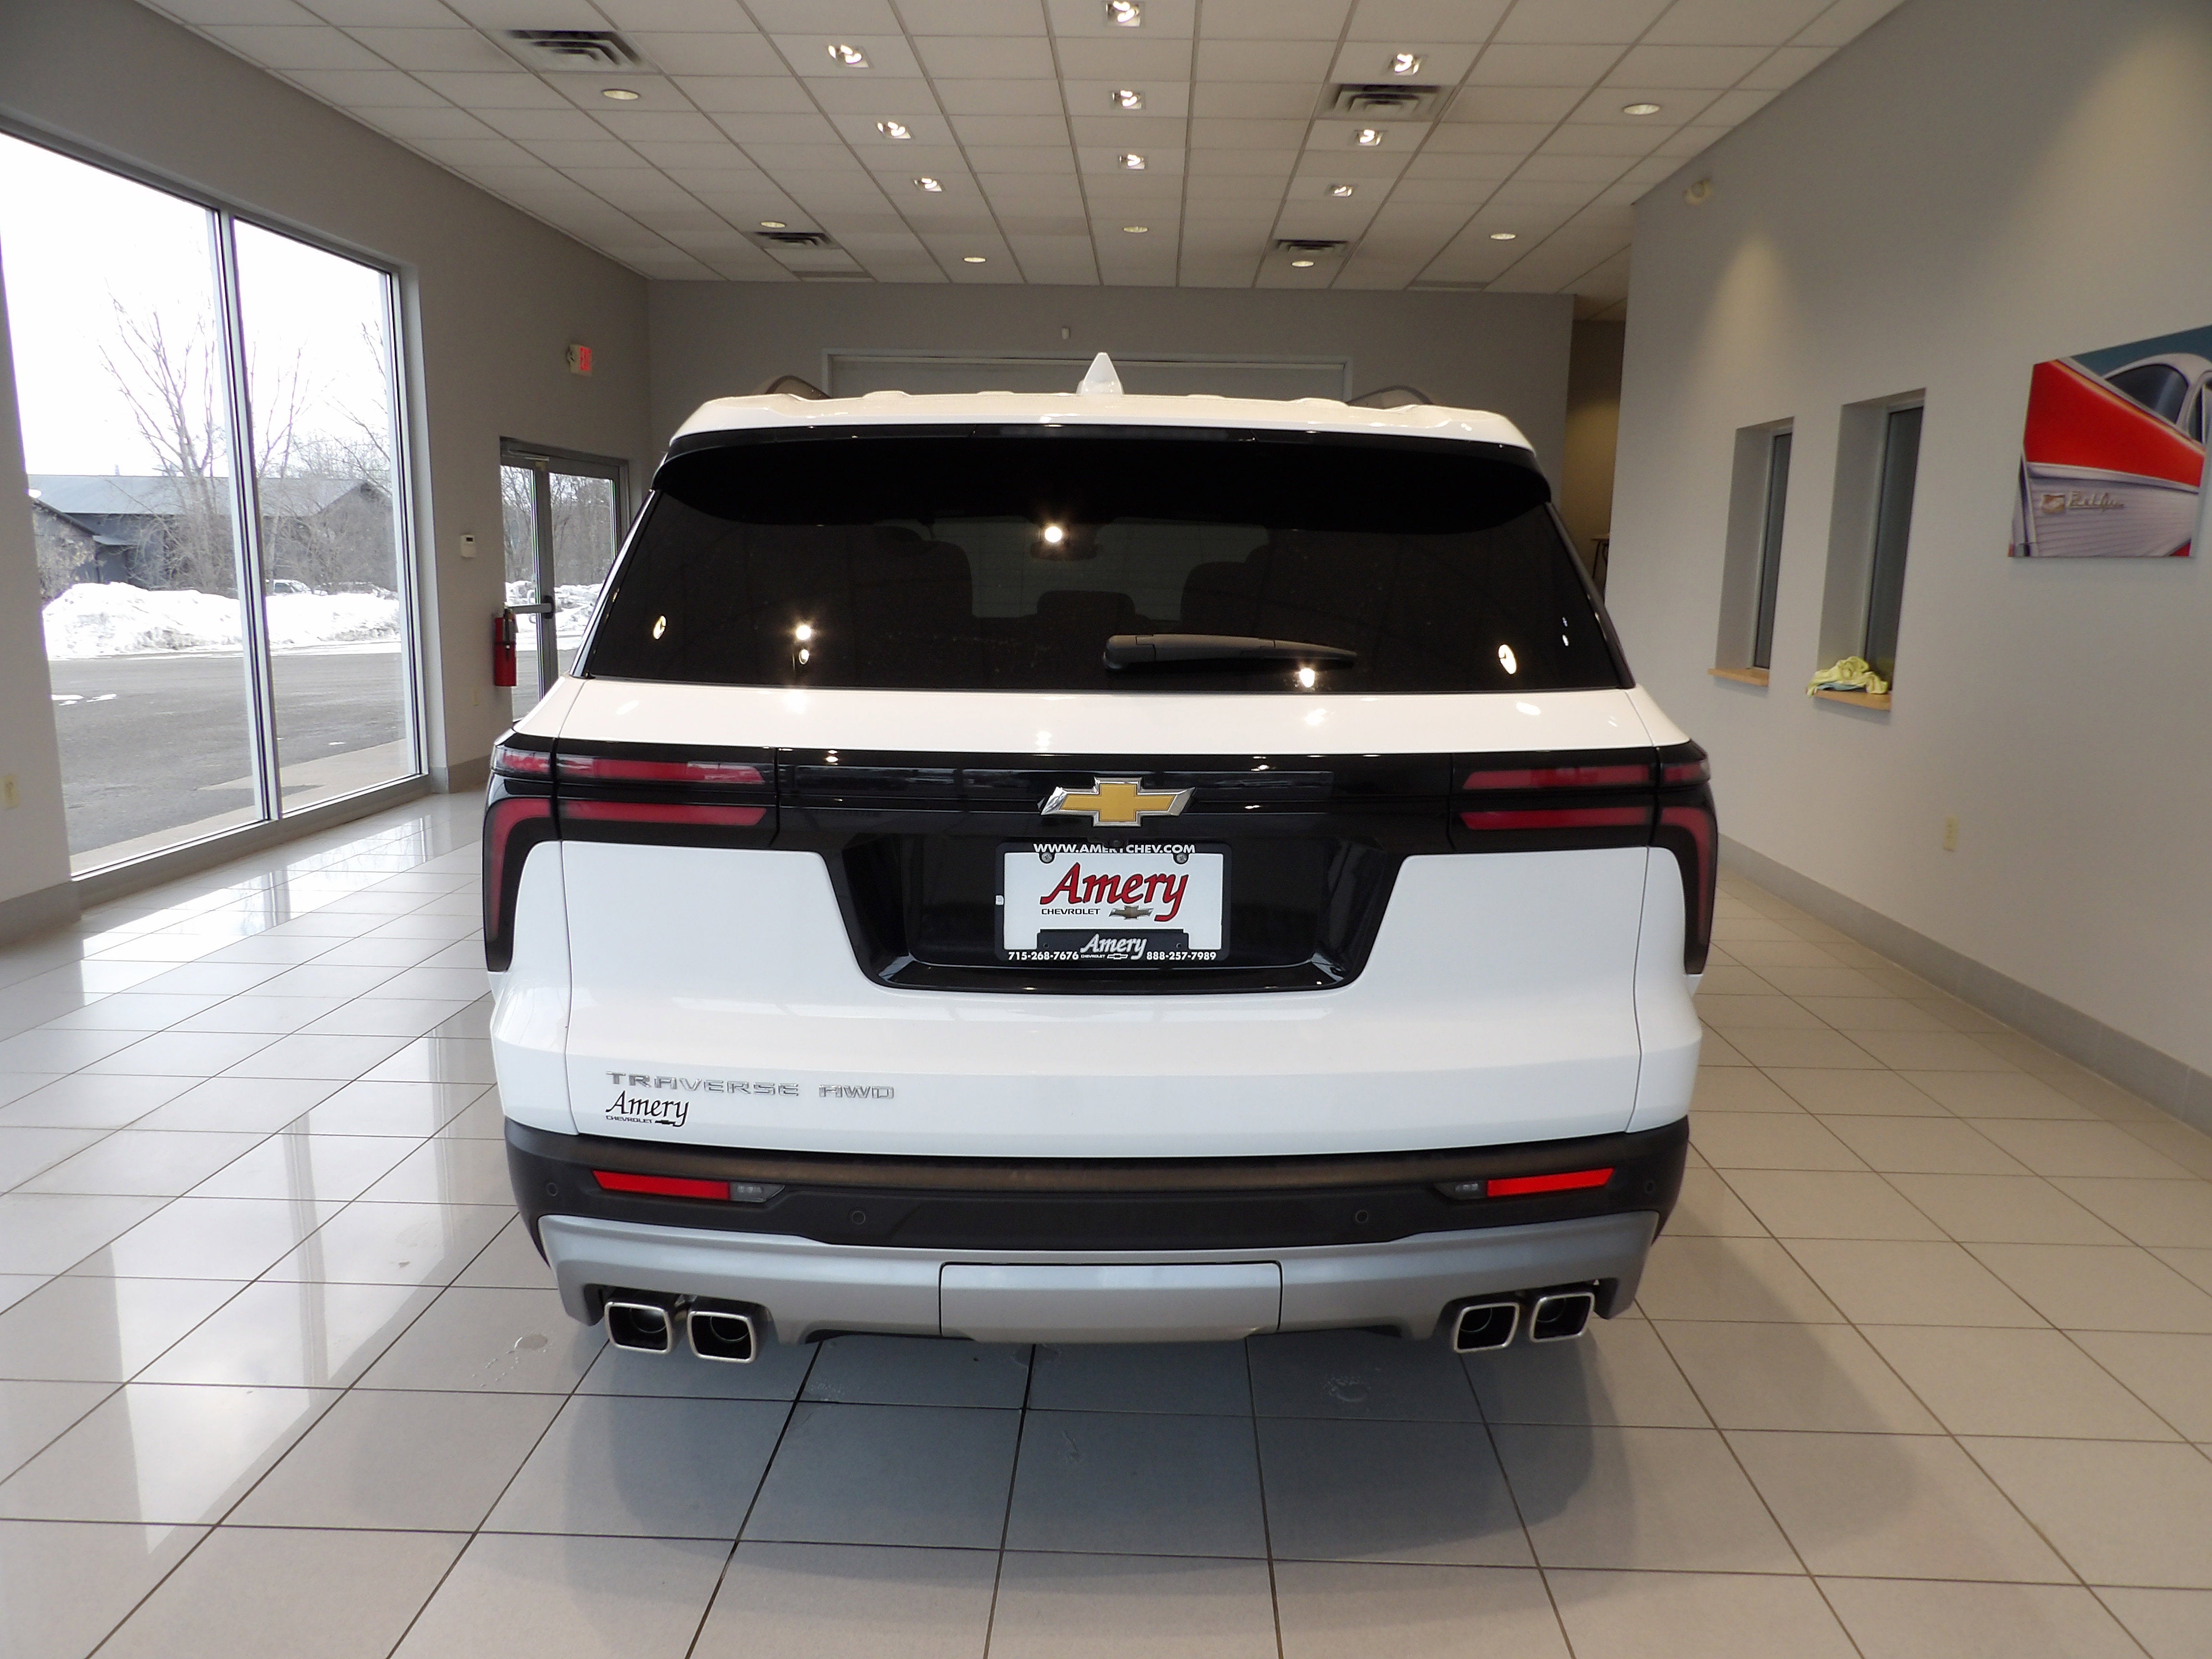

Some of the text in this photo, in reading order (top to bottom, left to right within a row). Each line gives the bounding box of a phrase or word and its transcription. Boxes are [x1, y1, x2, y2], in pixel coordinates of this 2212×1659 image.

[1040, 862, 1189, 922] Amery
[1009, 951, 1079, 960] 715-268-7676
[1080, 934, 1147, 960] Amery
[1147, 951, 1216, 960] 888-257-7989
[606, 1071, 894, 1099] TRAVERSE AWD
[605, 1090, 689, 1127] Amery
[606, 1115, 652, 1123] CHEVROLET
